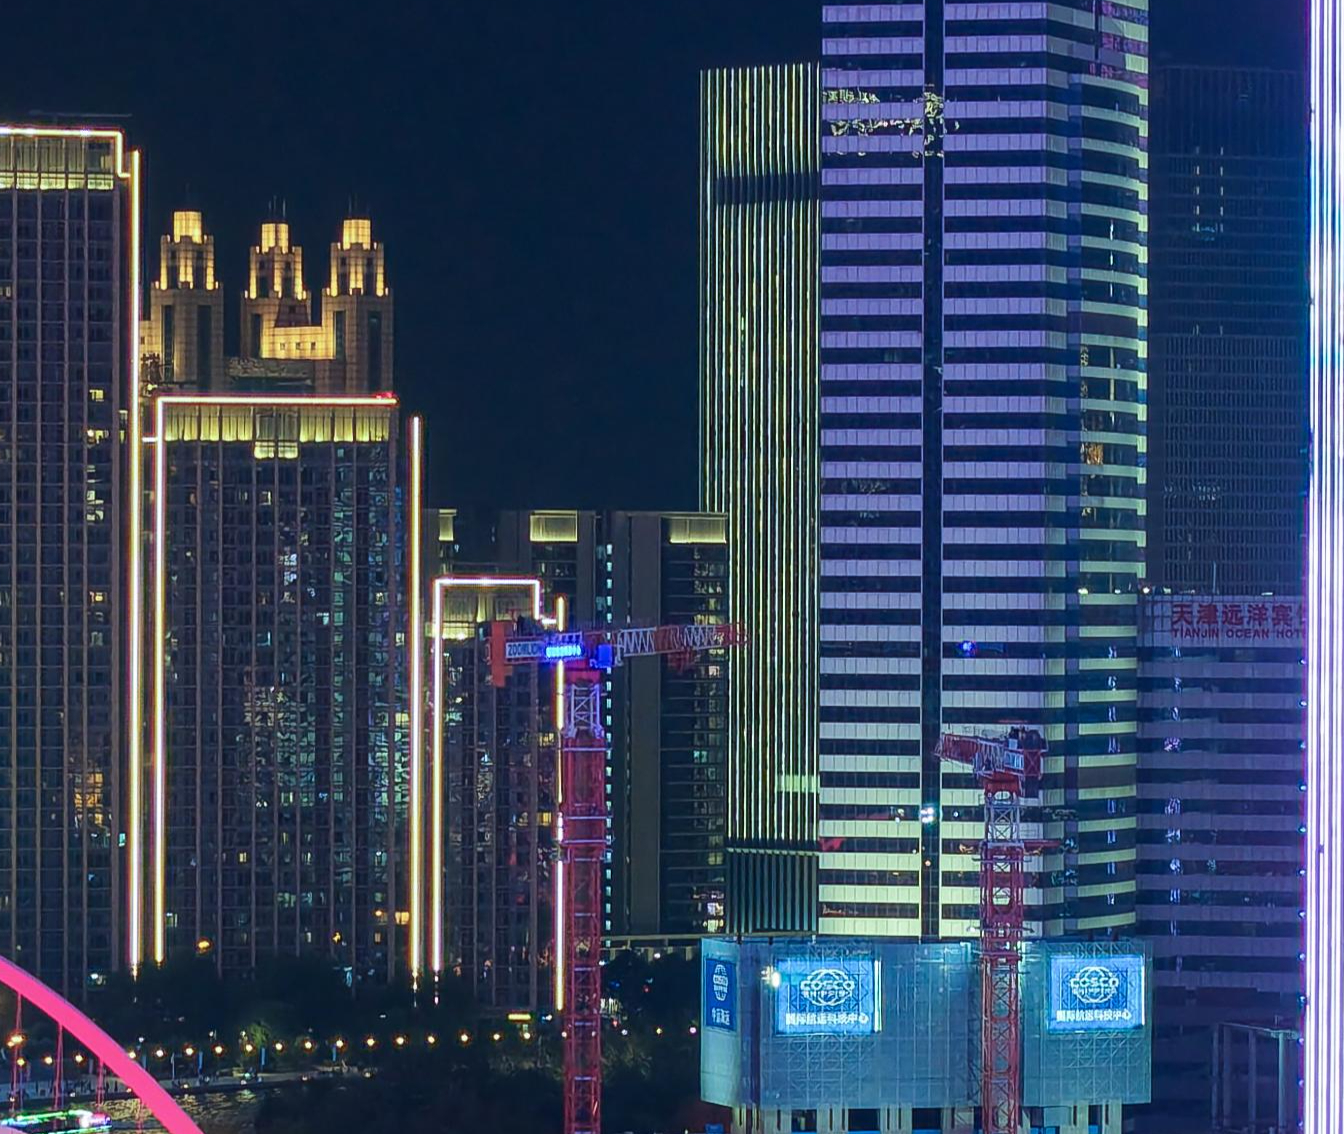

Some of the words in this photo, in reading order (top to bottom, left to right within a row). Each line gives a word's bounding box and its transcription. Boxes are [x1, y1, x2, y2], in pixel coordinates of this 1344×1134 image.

[1172, 628, 1219, 639] TIANJIN
[1226, 628, 1269, 639] OCEAN
[1276, 628, 1305, 639] HOT
[800, 980, 855, 991] COSCO
[1070, 977, 1119, 988] COSCO
